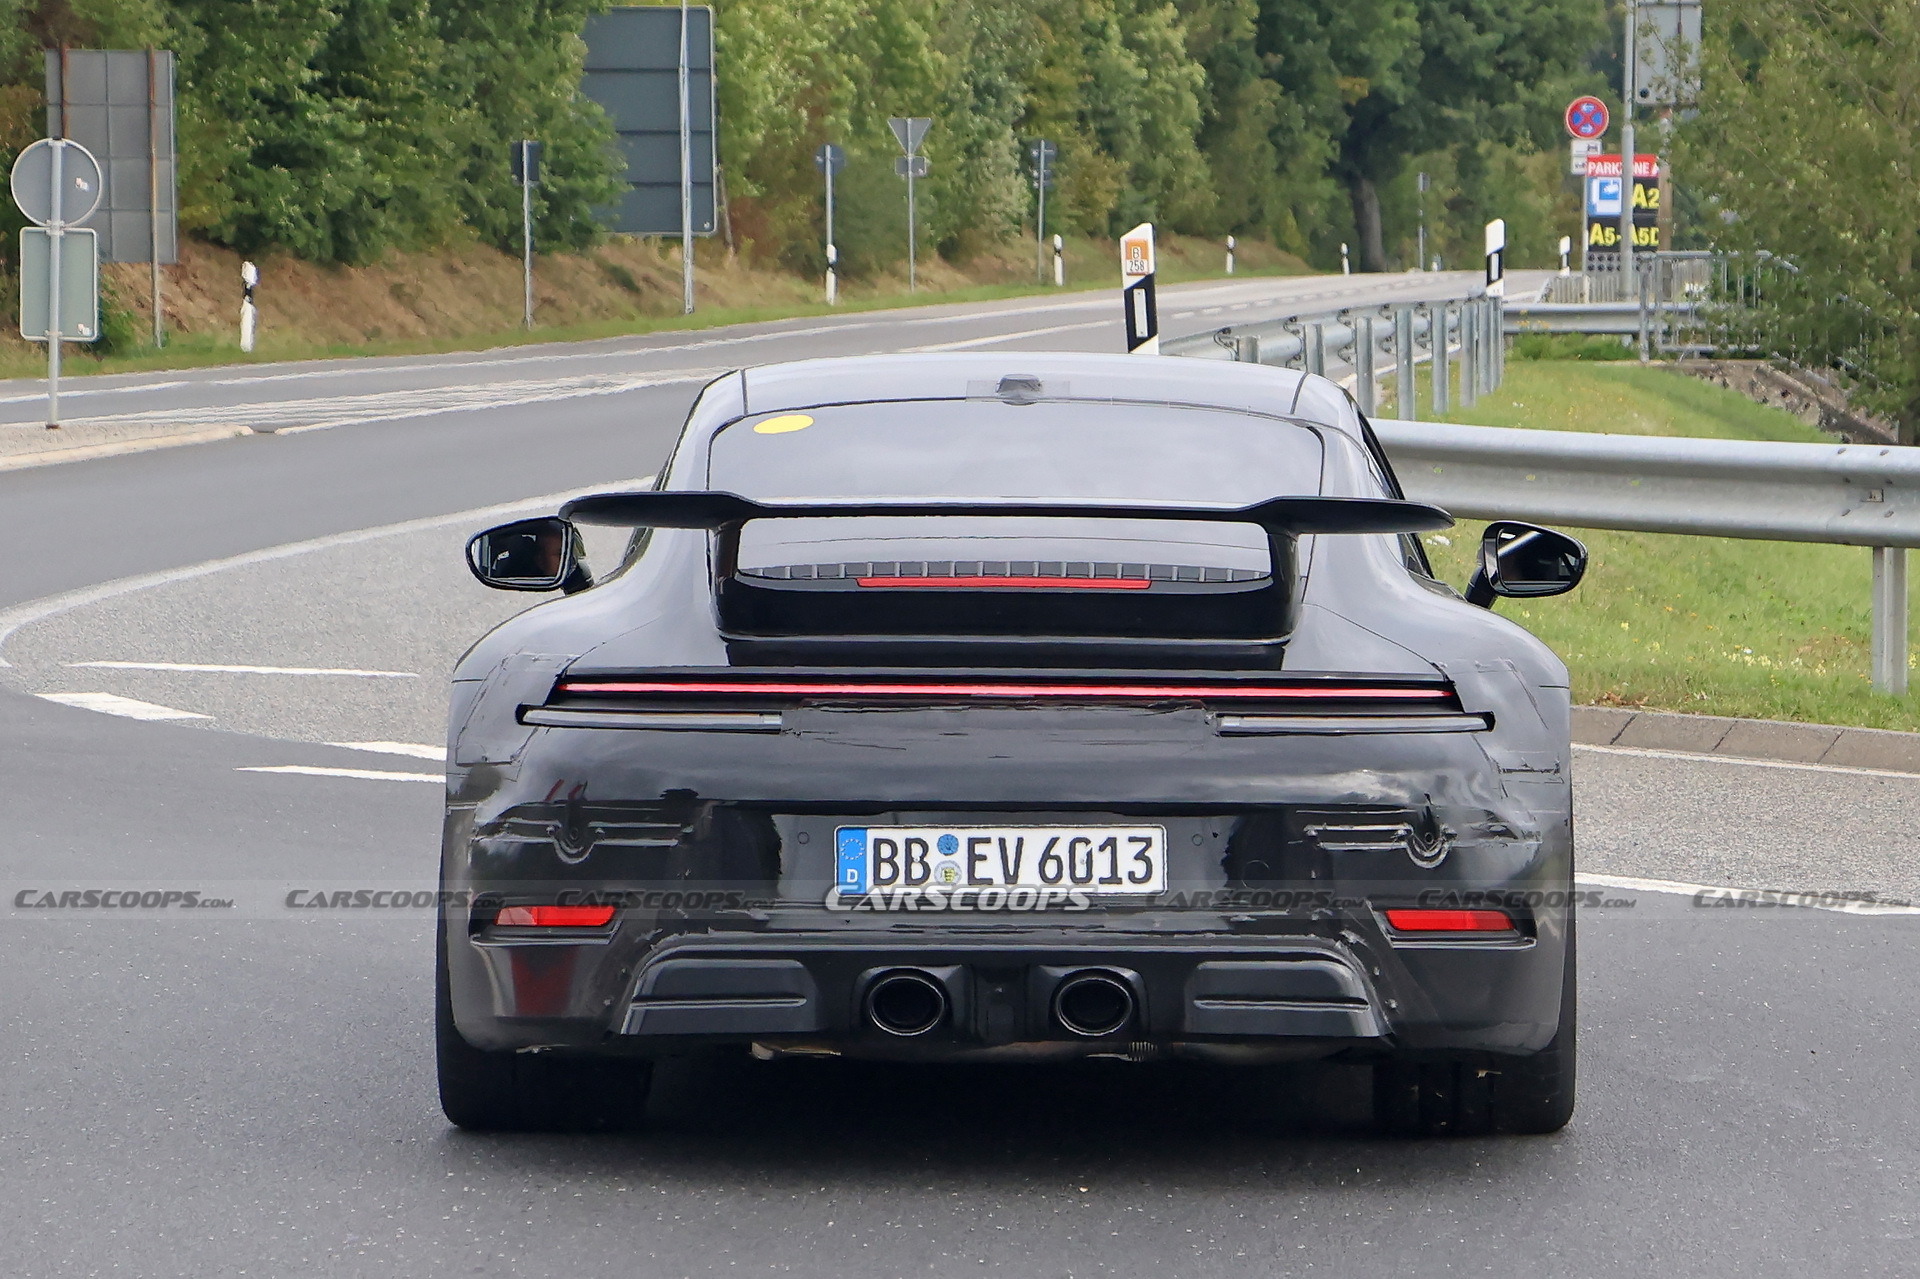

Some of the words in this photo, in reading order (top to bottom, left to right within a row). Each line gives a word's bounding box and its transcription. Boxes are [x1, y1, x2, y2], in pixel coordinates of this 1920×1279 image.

[1588, 162, 1650, 175] PARKNE
[1631, 183, 1660, 209] A2
[1132, 247, 1140, 259] B
[1129, 260, 1145, 272] 258
[872, 836, 931, 886] BB
[967, 836, 1025, 886] EV
[1038, 836, 1155, 885] 6013
[846, 868, 858, 883] D
